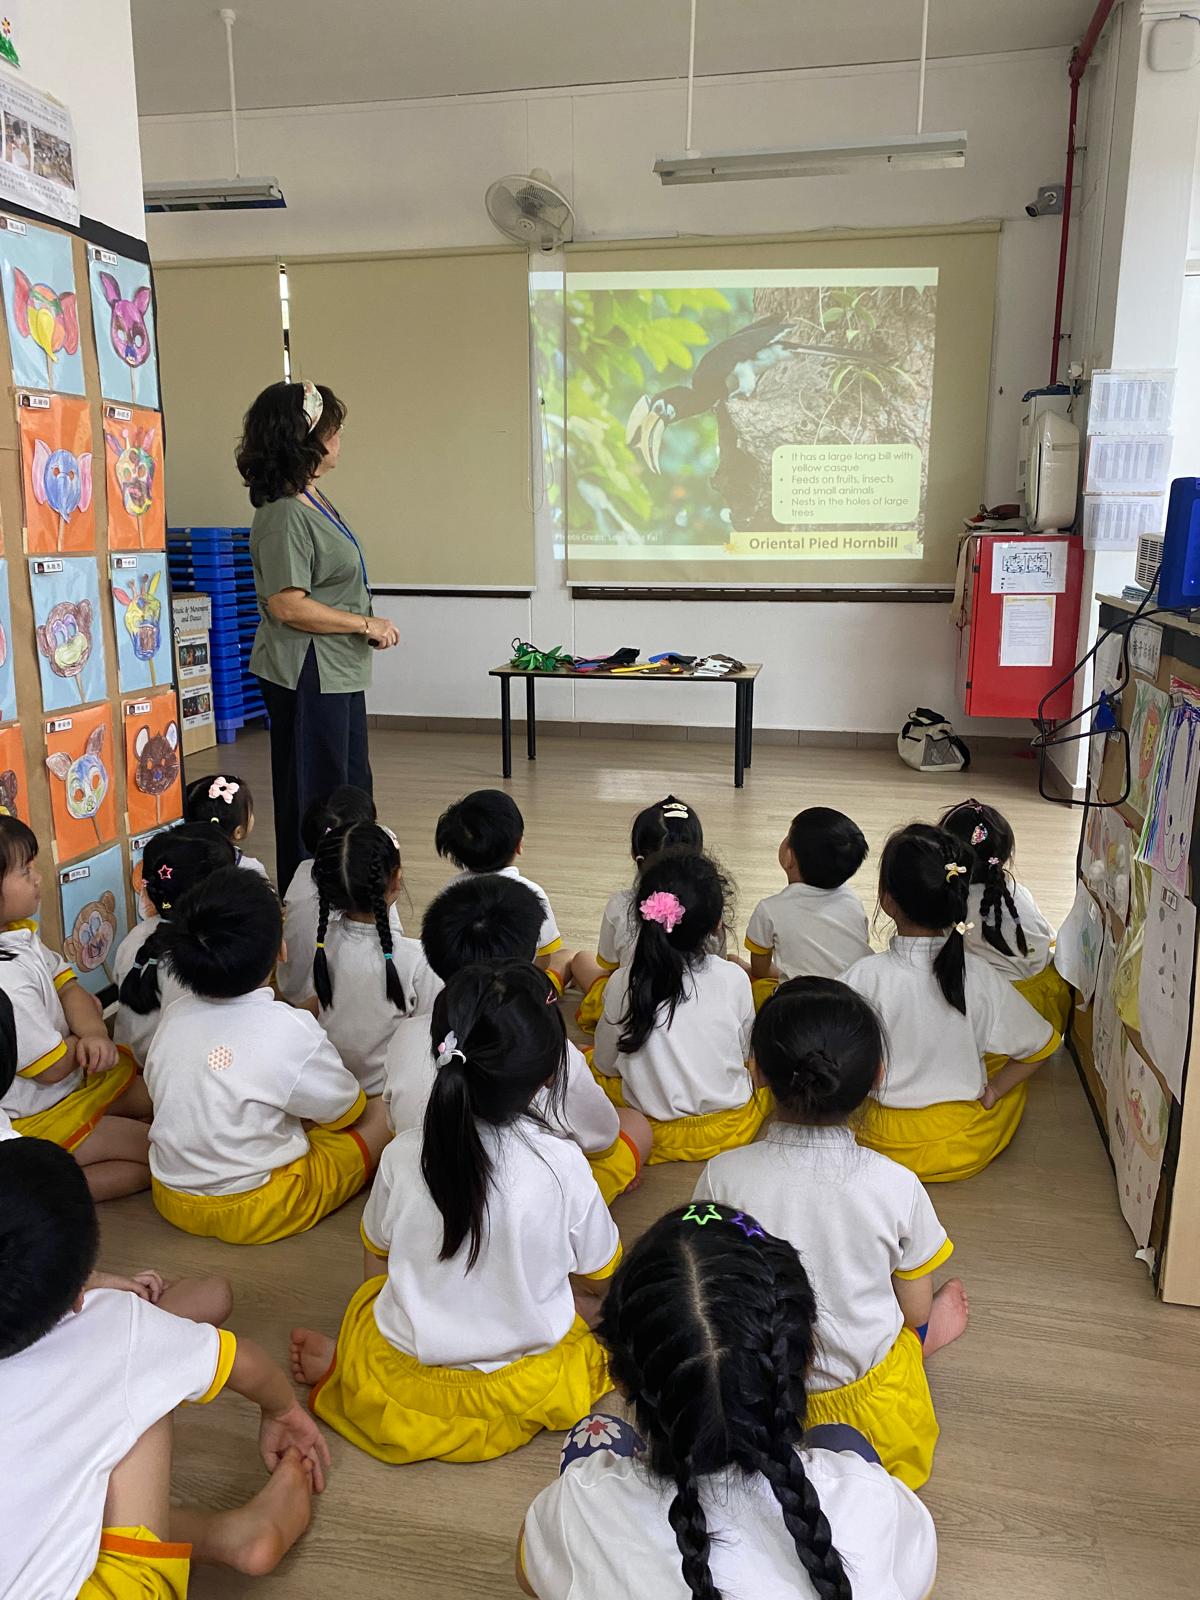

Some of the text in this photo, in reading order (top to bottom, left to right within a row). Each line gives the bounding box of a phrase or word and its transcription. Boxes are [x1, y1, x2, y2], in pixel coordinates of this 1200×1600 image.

[791, 452, 798, 461] It
[800, 452, 817, 461] has
[828, 452, 853, 463] large
[855, 452, 876, 462] long
[878, 451, 892, 460] bill
[893, 452, 913, 460] with
[791, 463, 860, 473] yellow casque
[791, 475, 820, 484] Feeds
[821, 476, 834, 484] on
[862, 474, 894, 484] insects
[791, 486, 875, 495] and small animals
[791, 497, 909, 507] Nests in the holes of large
[791, 509, 815, 517] trees
[749, 536, 898, 550] Oriental Pied Hornbill
